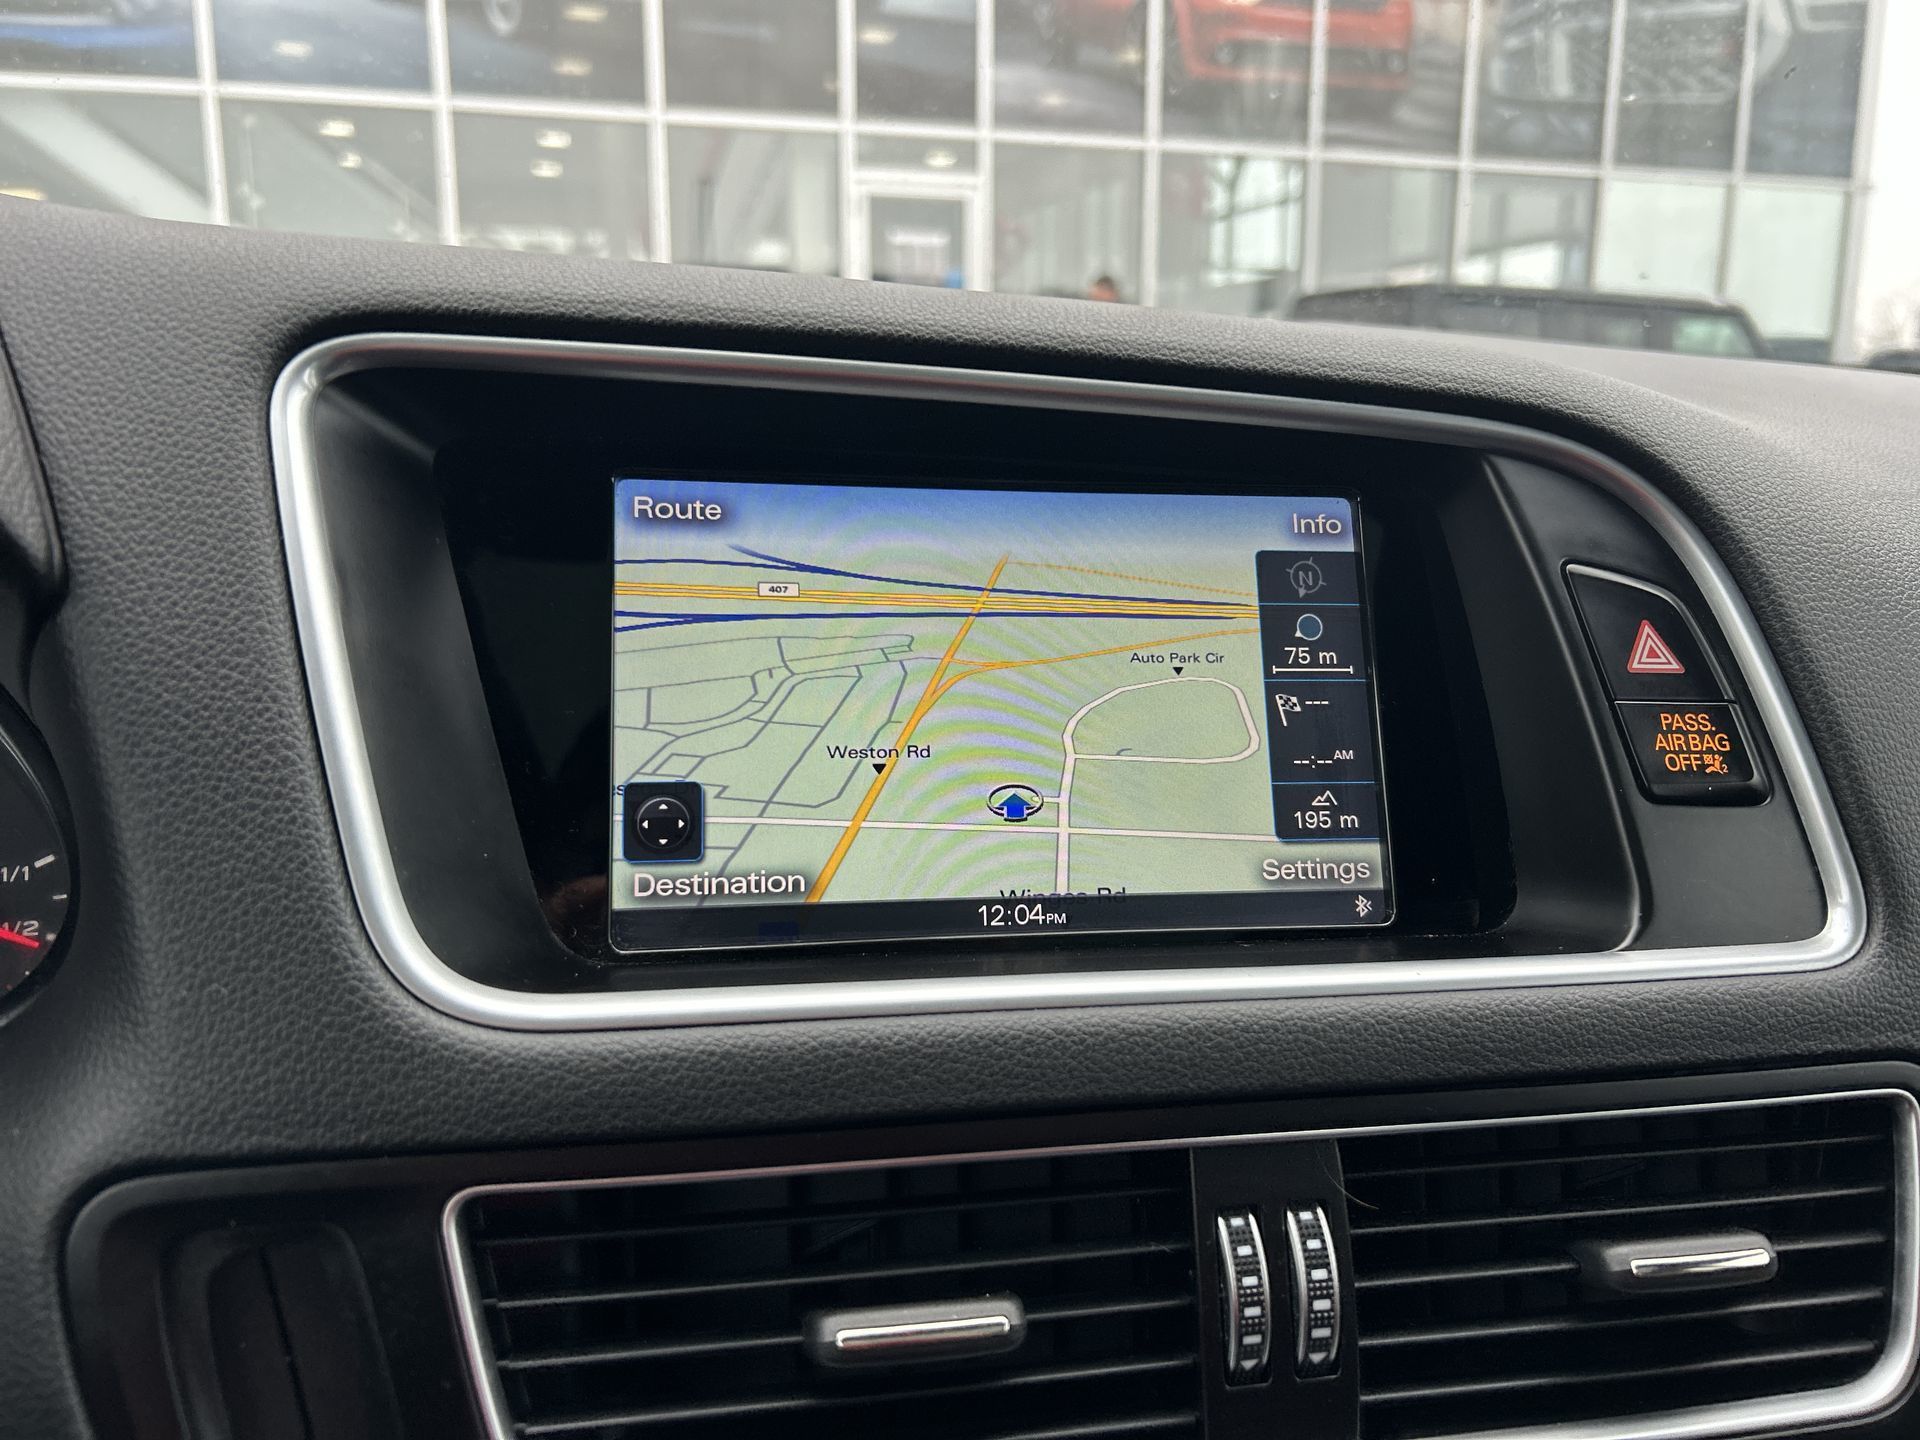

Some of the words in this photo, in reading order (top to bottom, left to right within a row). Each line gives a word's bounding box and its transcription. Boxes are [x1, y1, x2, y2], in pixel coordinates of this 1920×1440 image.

[633, 496, 722, 520] Route
[1292, 513, 1342, 534] Info
[768, 585, 788, 594] 407
[1131, 652, 1165, 664] Auto
[1169, 652, 1200, 664] Park
[1205, 653, 1225, 664] Cir
[1284, 647, 1311, 665] 75
[1319, 651, 1337, 665] m
[1659, 713, 1716, 731] PASS.
[827, 745, 899, 759] Weston
[906, 744, 931, 759] Rd
[1664, 753, 1702, 772] OFF
[1293, 811, 1331, 829] 195
[1340, 815, 1359, 829] m
[0, 865, 30, 883] 1/1
[1262, 857, 1371, 884] Settings
[633, 869, 806, 897] Destination
